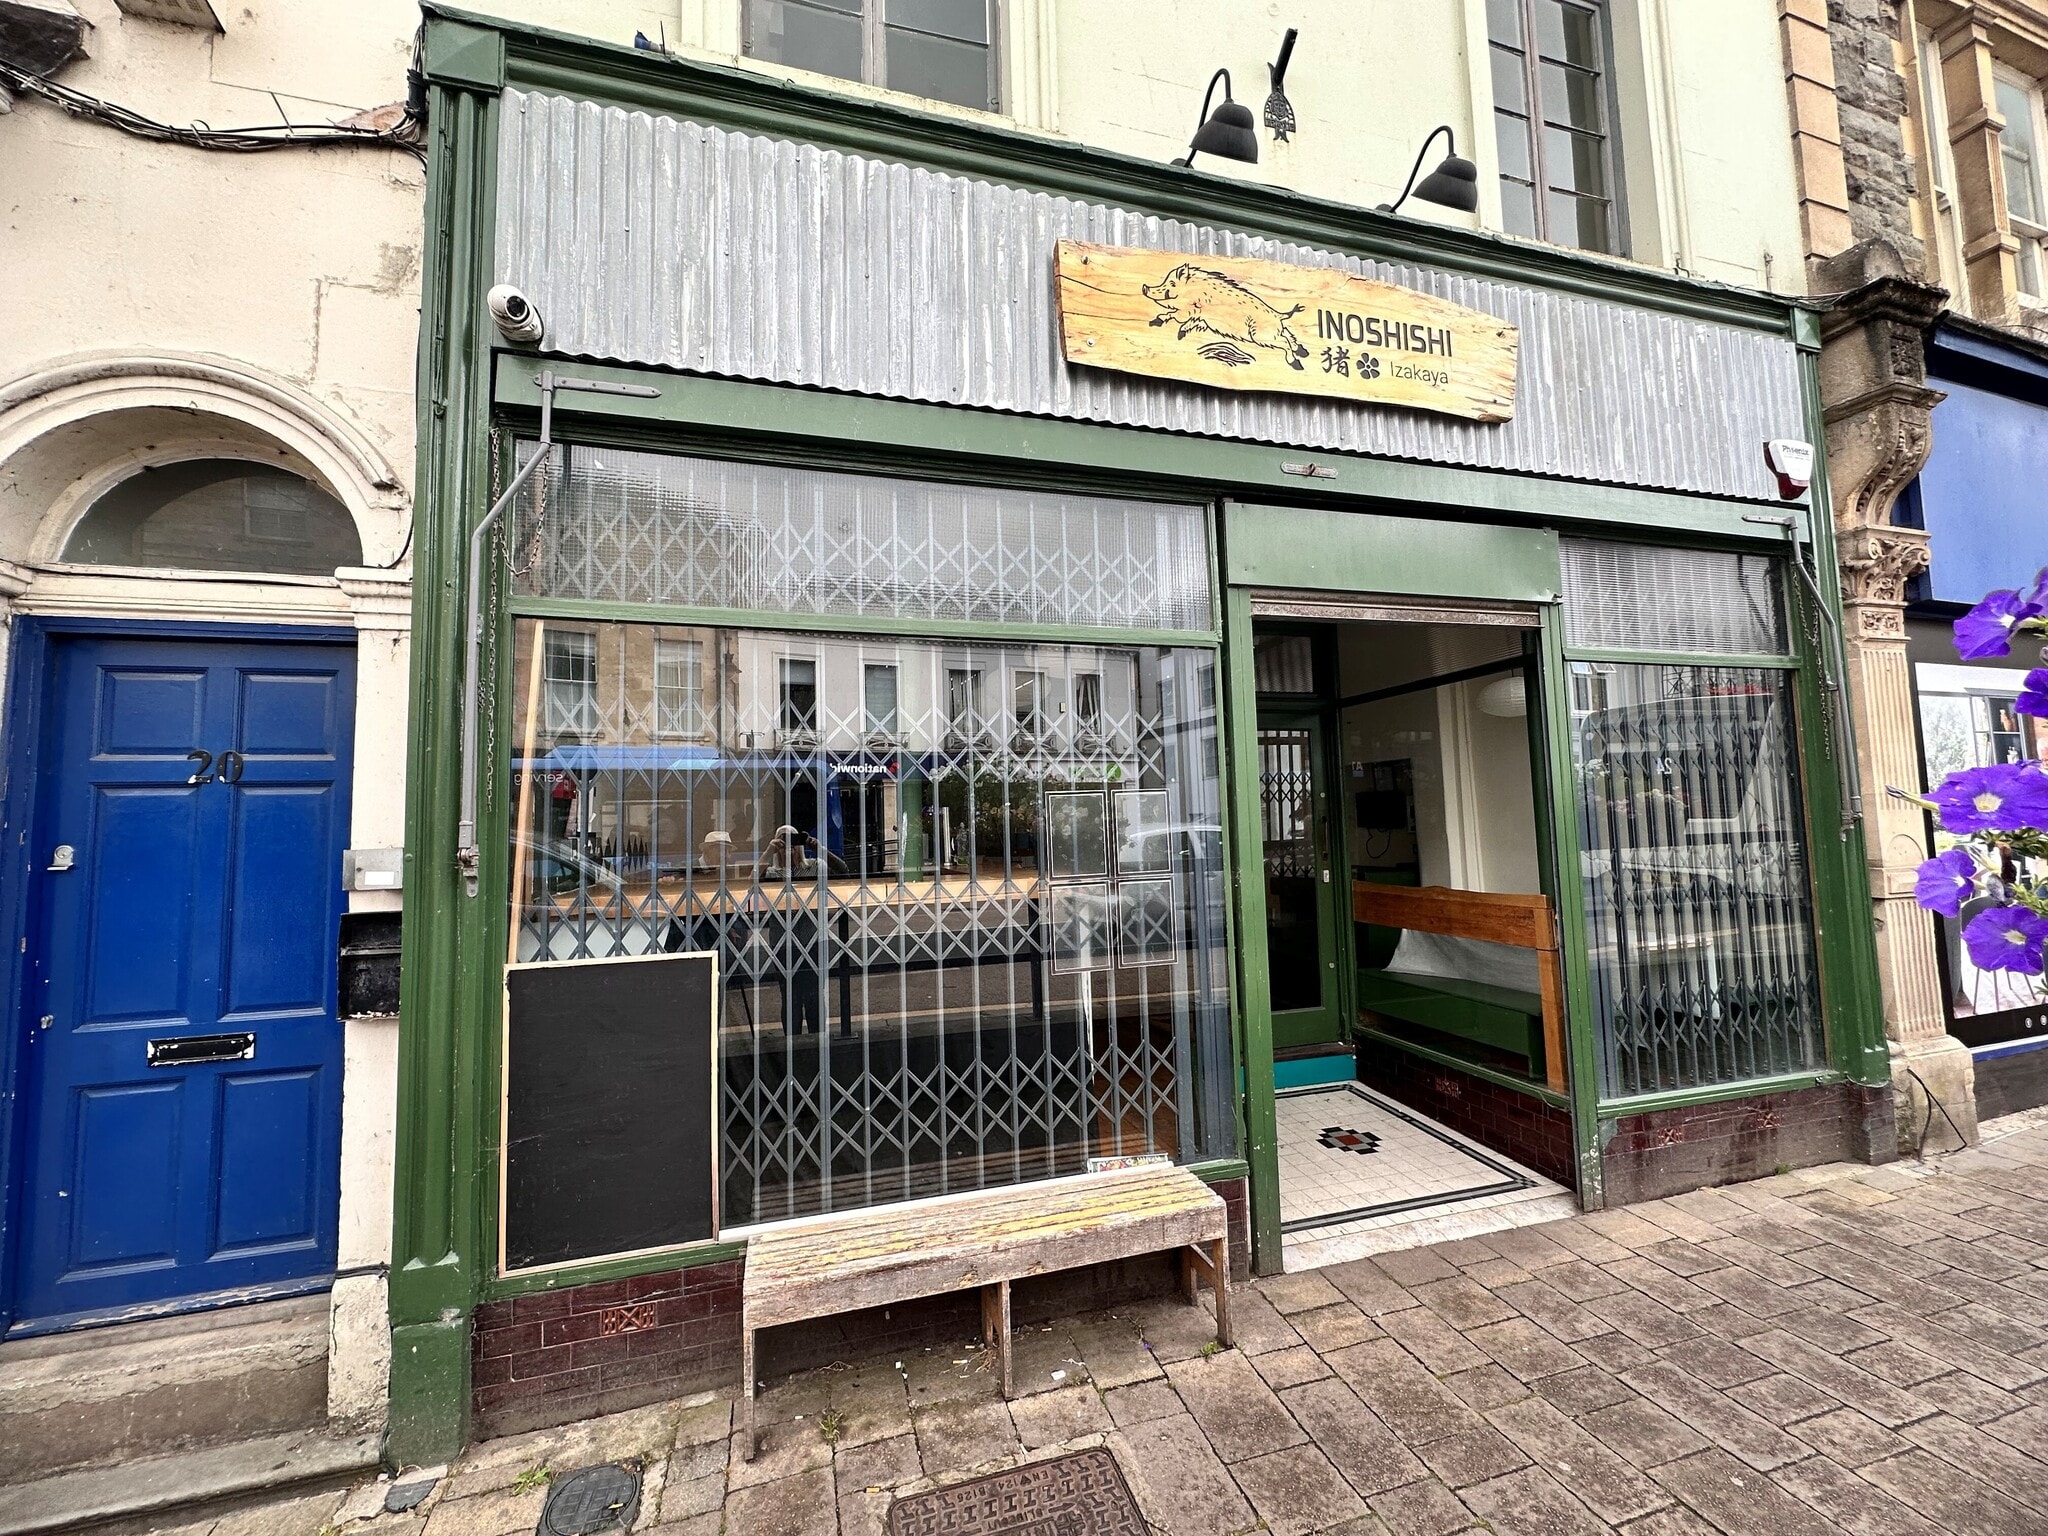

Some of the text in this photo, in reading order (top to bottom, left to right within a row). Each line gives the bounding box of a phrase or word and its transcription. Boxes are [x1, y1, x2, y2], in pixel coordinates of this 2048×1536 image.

[1317, 308, 1452, 357] INOSHISHI
[1320, 345, 1351, 378] 猪
[1390, 361, 1449, 387] Izakaya
[187, 748, 244, 784] 20
